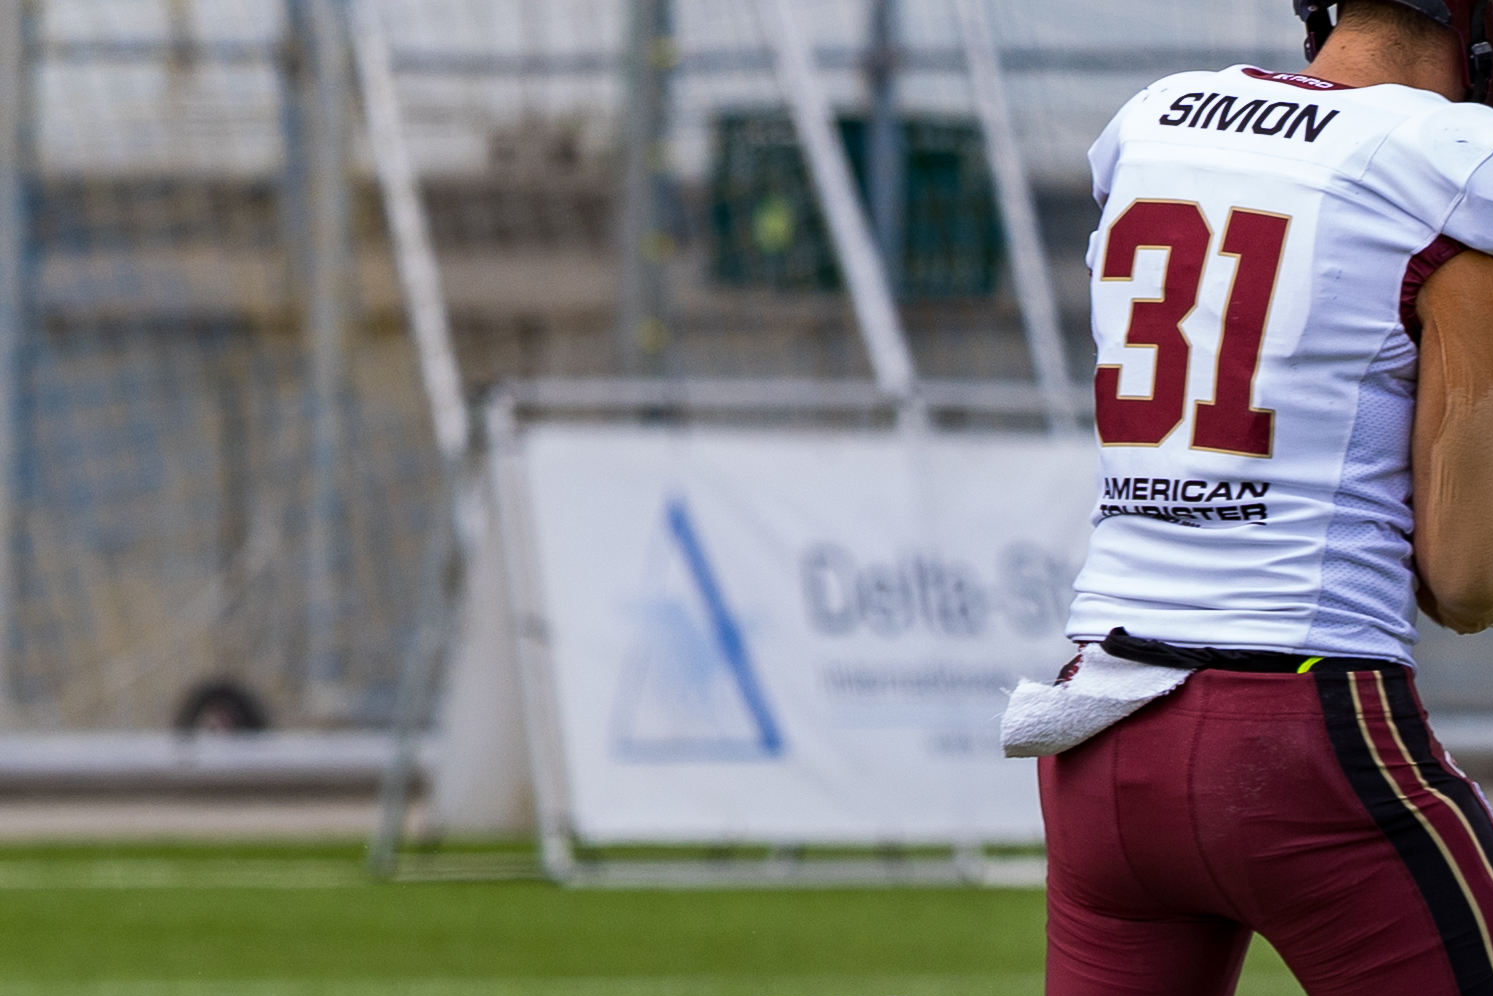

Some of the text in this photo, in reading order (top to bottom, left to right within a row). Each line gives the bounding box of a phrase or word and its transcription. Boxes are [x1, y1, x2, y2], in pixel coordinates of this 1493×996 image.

[1158, 91, 1341, 142] SIMON
[1095, 198, 1292, 458] 31
[1102, 477, 1271, 502] AMERICAN
